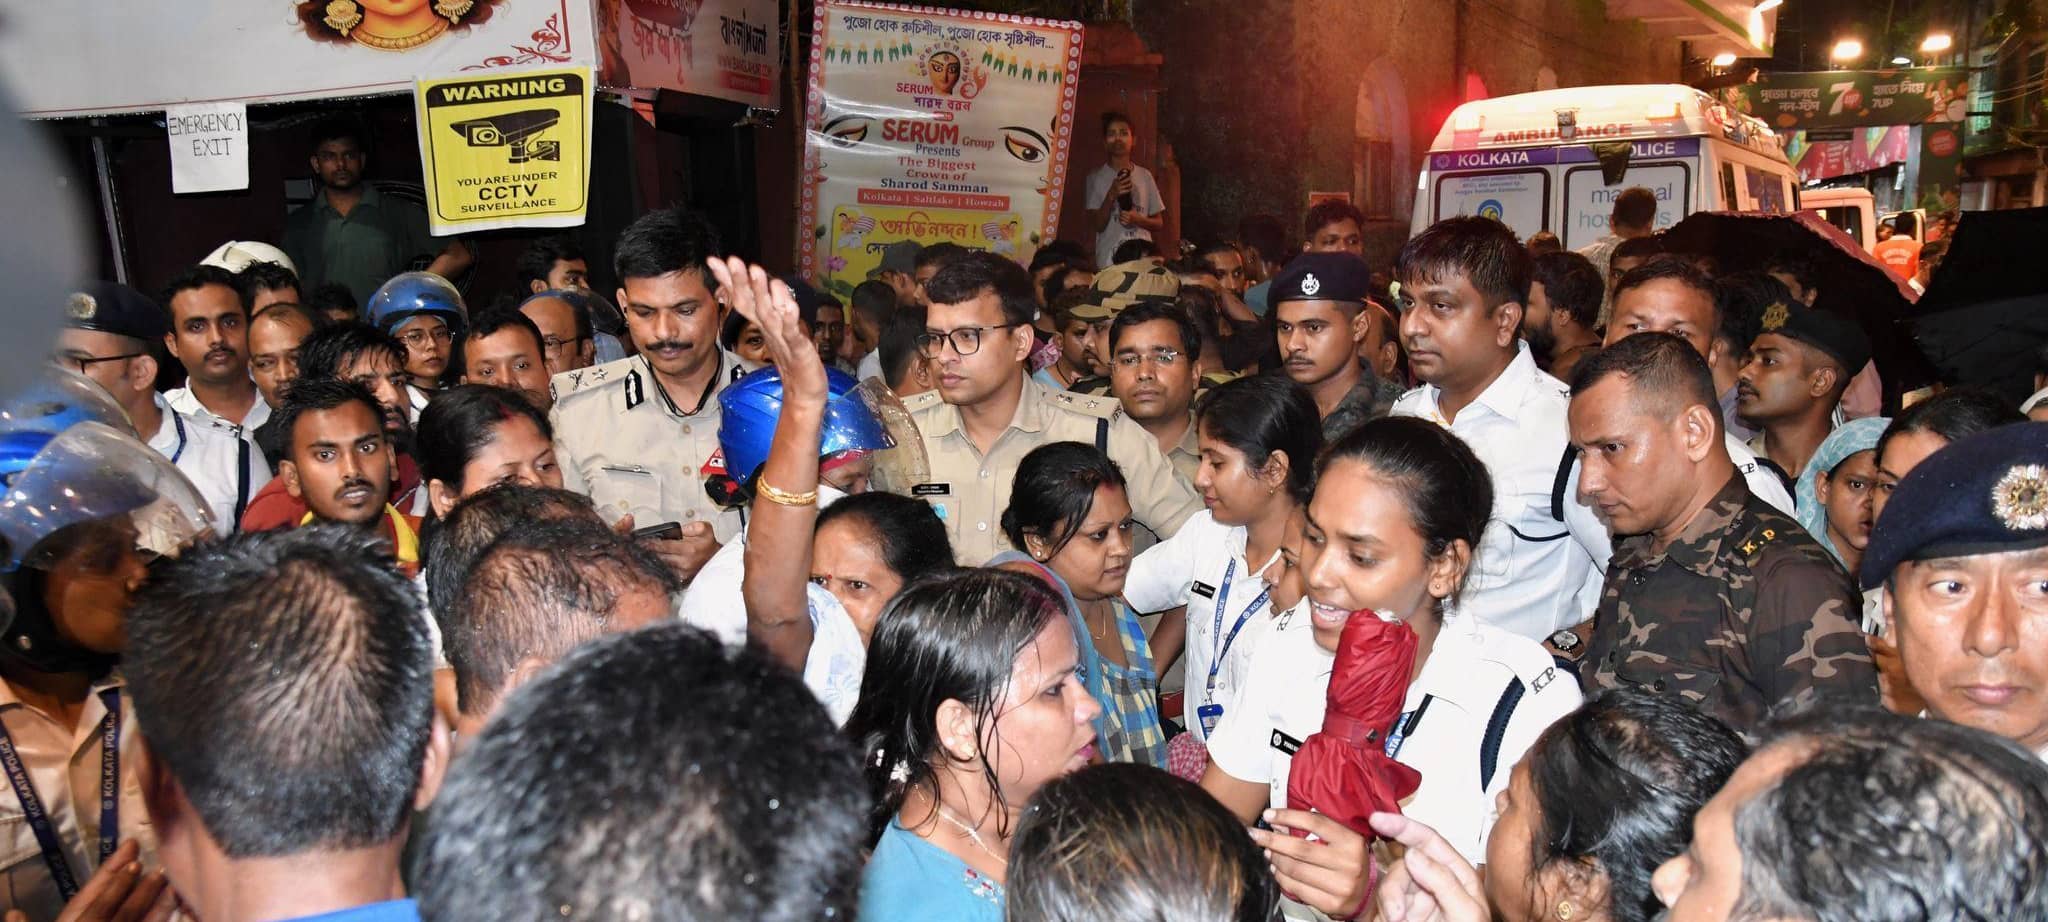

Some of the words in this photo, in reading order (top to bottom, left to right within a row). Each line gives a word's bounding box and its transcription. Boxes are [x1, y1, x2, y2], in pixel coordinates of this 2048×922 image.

[843, 15, 871, 31] পুজো
[874, 18, 898, 33] হোক
[902, 19, 945, 39] রুচিশীল,
[946, 26, 975, 43] পুজো
[977, 29, 1002, 43] হোক
[442, 78, 566, 102] WARNING
[896, 82, 934, 95] SERUM
[1872, 97, 1894, 109] 7UP
[168, 112, 242, 136] EMERGENCY
[881, 117, 960, 146] SERUM
[962, 136, 995, 151] Group
[1493, 122, 1633, 145] AMBUANCE
[192, 137, 233, 156] EXIT
[915, 143, 961, 157] Presents
[1457, 151, 1530, 168] KOLKATA
[1630, 141, 1676, 158] OLICE
[897, 156, 924, 167] The
[927, 157, 976, 171] Biggest
[456, 178, 483, 187] YOU
[484, 175, 510, 185] ARE
[512, 171, 558, 182] UNDER
[906, 168, 949, 181] Crown
[953, 172, 968, 181] of
[478, 183, 539, 201] CCTV
[880, 177, 928, 190] Sharod
[931, 180, 989, 194] Samman
[460, 198, 558, 213] SURVEILLANCE
[863, 191, 902, 202] Kolkata
[913, 195, 954, 204] Saltlake
[965, 198, 1005, 208] Howrah
[103, 749, 115, 798] KOLKATA
